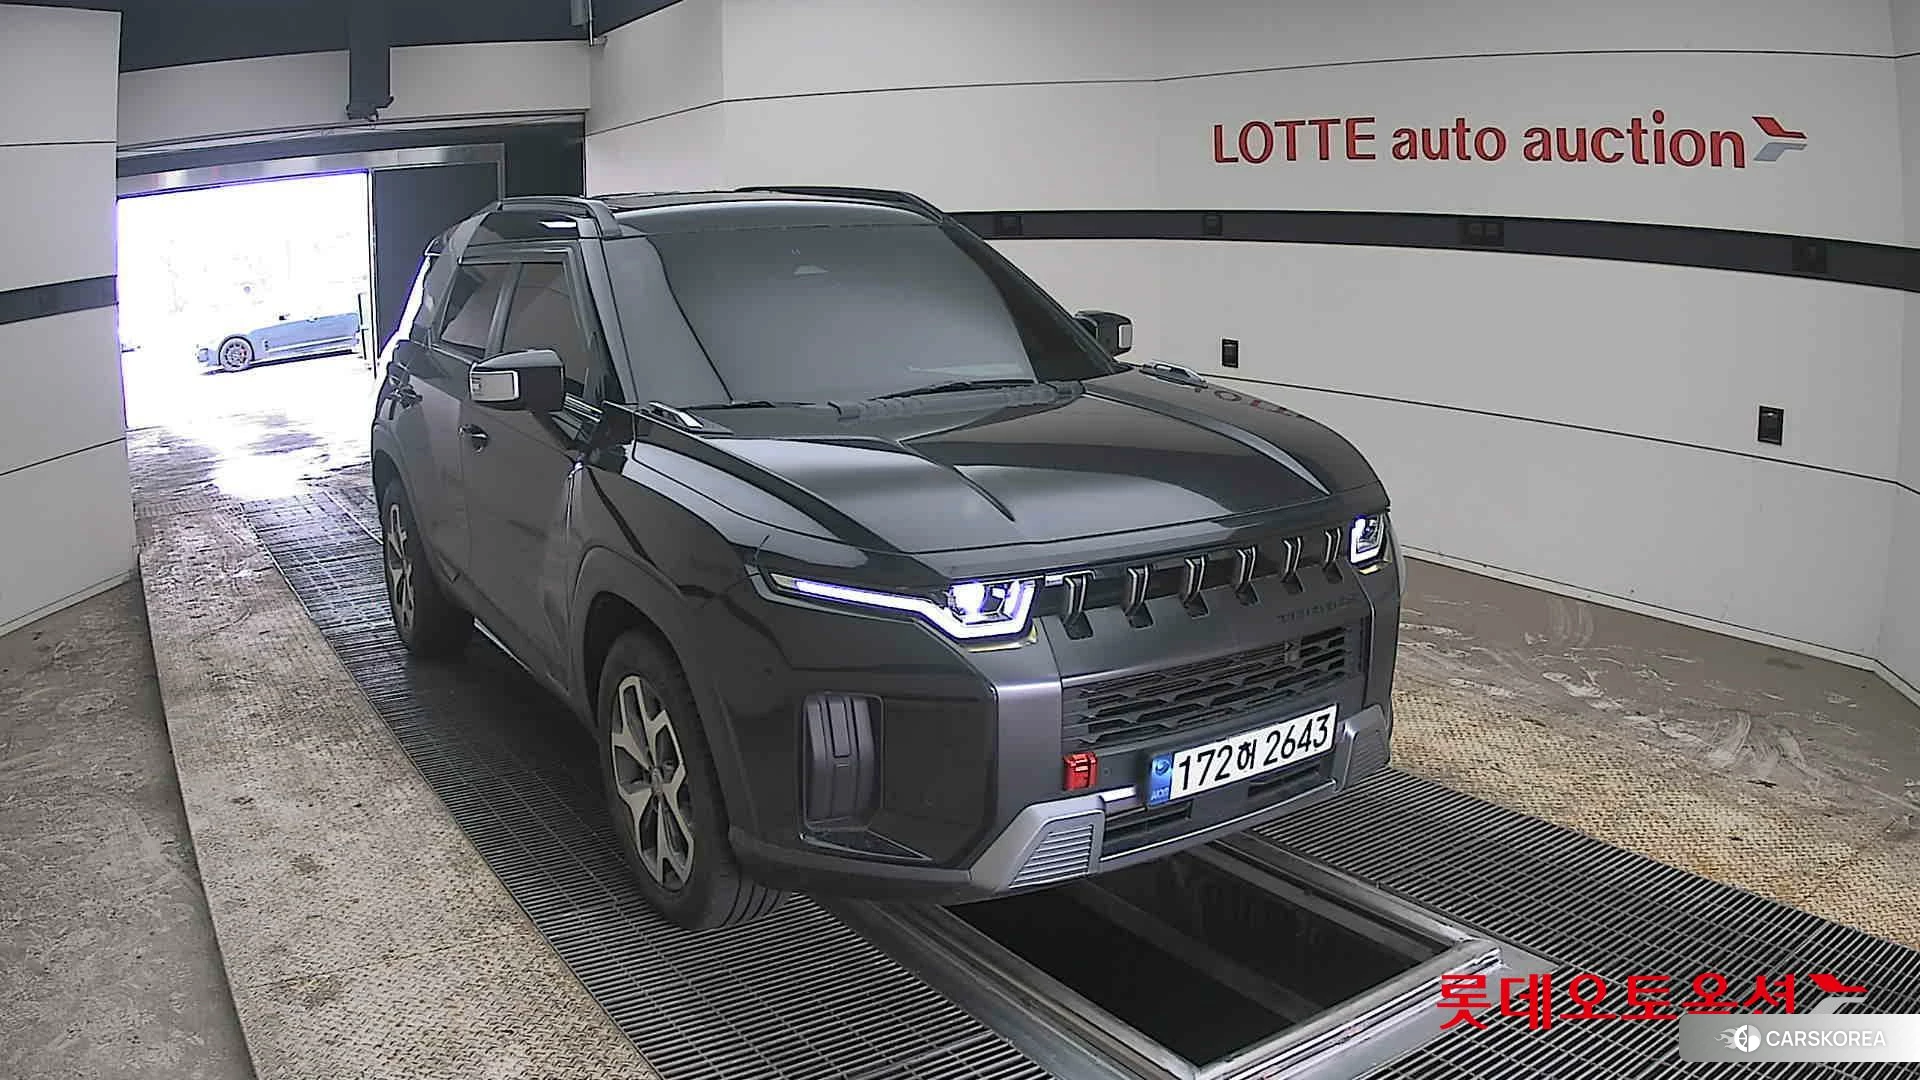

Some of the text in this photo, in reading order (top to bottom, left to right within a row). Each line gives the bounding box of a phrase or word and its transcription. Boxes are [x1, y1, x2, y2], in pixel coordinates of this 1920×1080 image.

[1213, 108, 1746, 169] LOTTE auto auction
[1263, 713, 1330, 766] 2643
